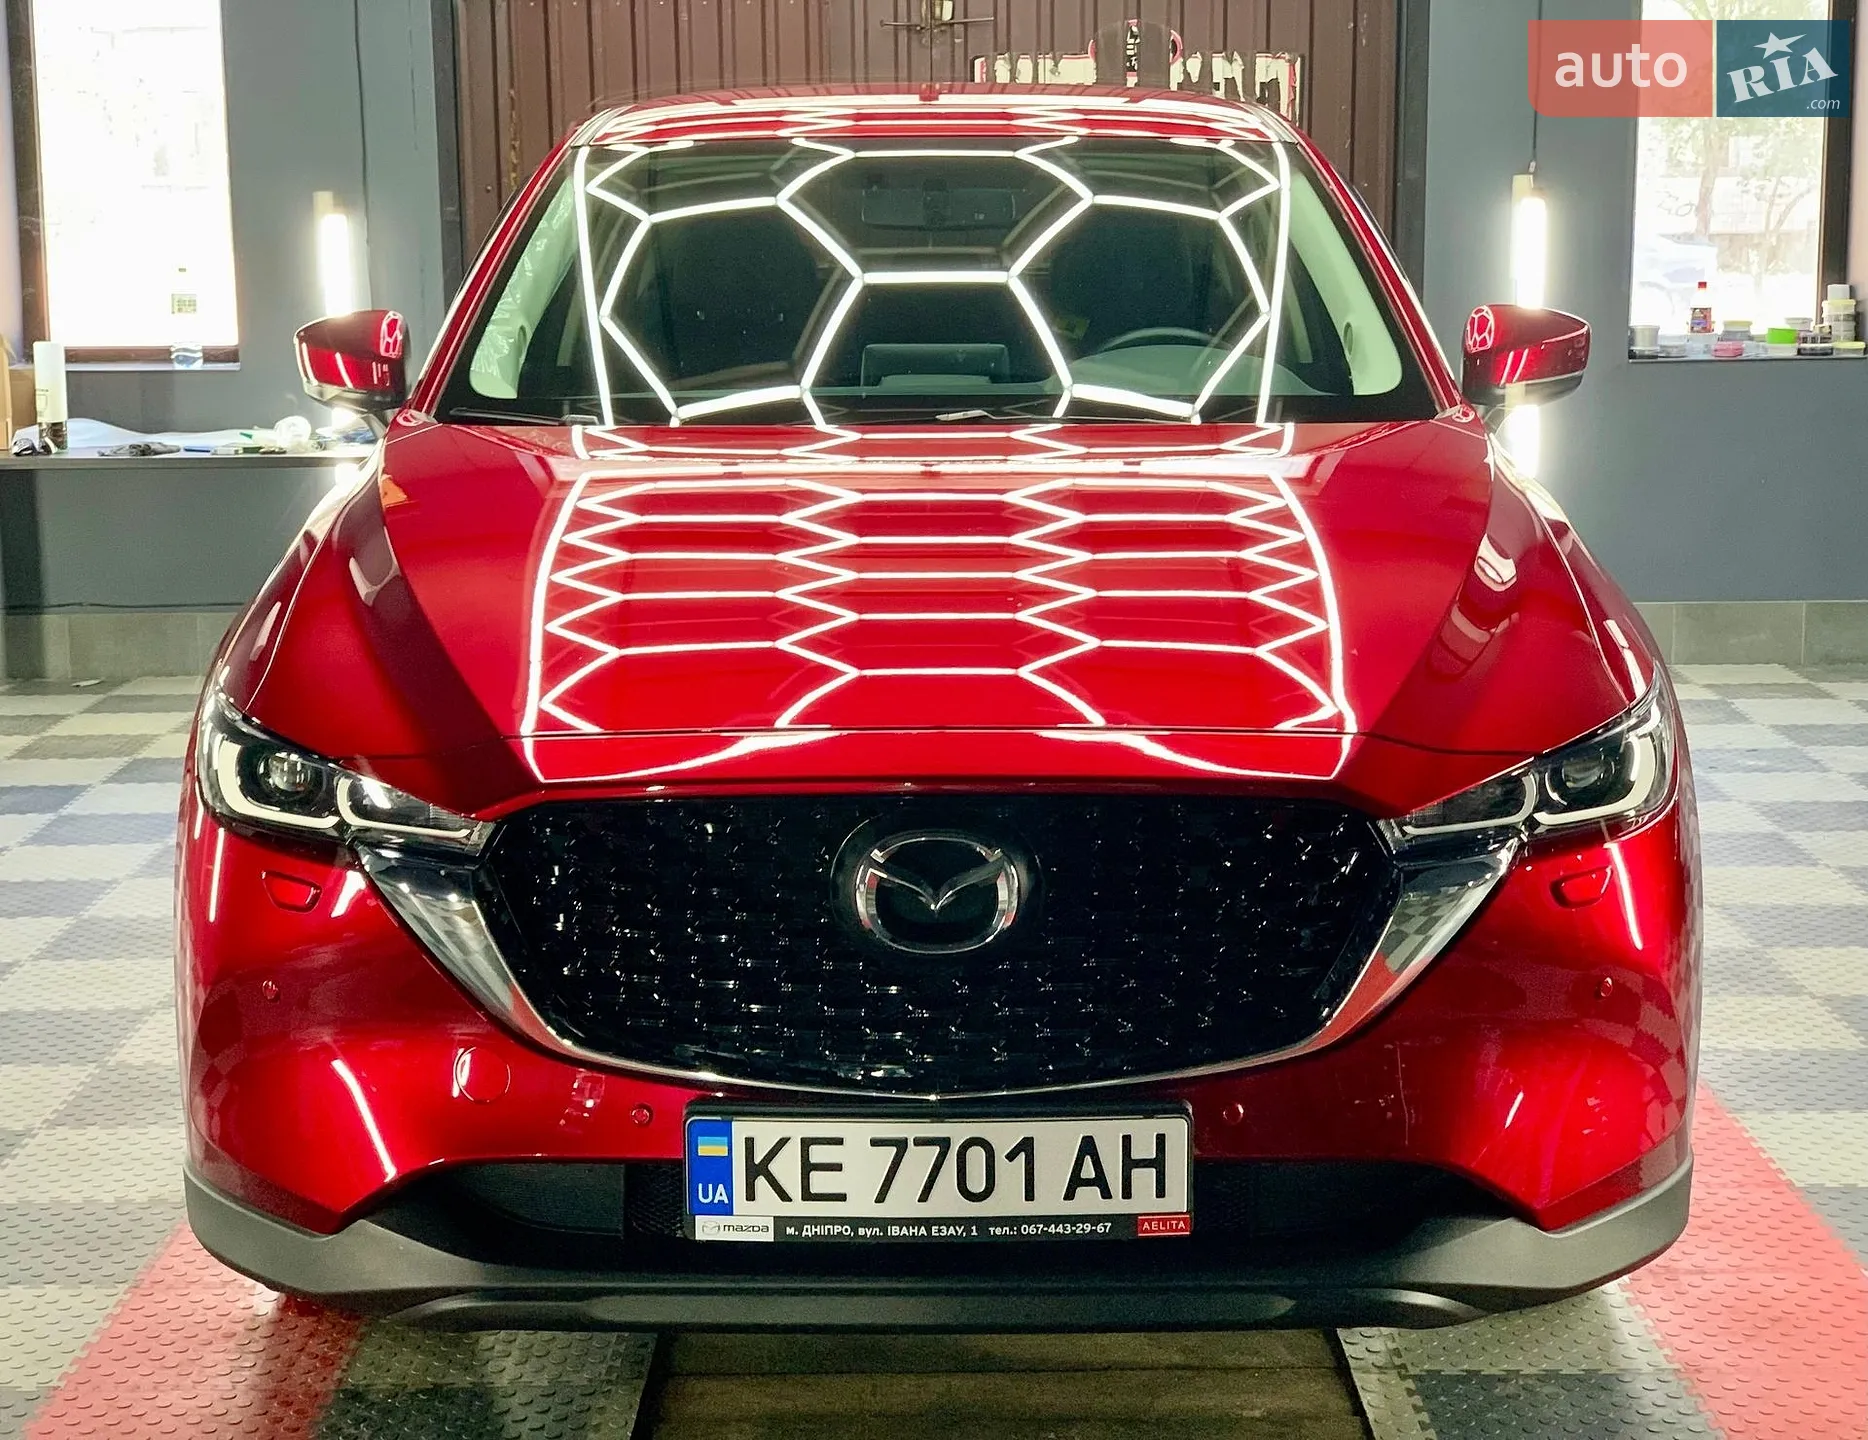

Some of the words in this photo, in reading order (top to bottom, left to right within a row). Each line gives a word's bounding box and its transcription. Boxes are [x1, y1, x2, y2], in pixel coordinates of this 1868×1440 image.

[744, 1136, 847, 1203] KE
[869, 1136, 1035, 1204] 7701
[1062, 1133, 1166, 1202] AH
[698, 1183, 729, 1204] UA
[786, 1227, 799, 1236] м.
[802, 1224, 855, 1238] ДНІПРО,
[858, 1227, 883, 1238] вул.
[887, 1225, 927, 1237] ІВАНА
[971, 1225, 978, 1236] 1
[988, 1226, 1018, 1236] тел.:
[1020, 1222, 1112, 1236] 067-443-29-67
[1142, 1218, 1186, 1231] AELITA
